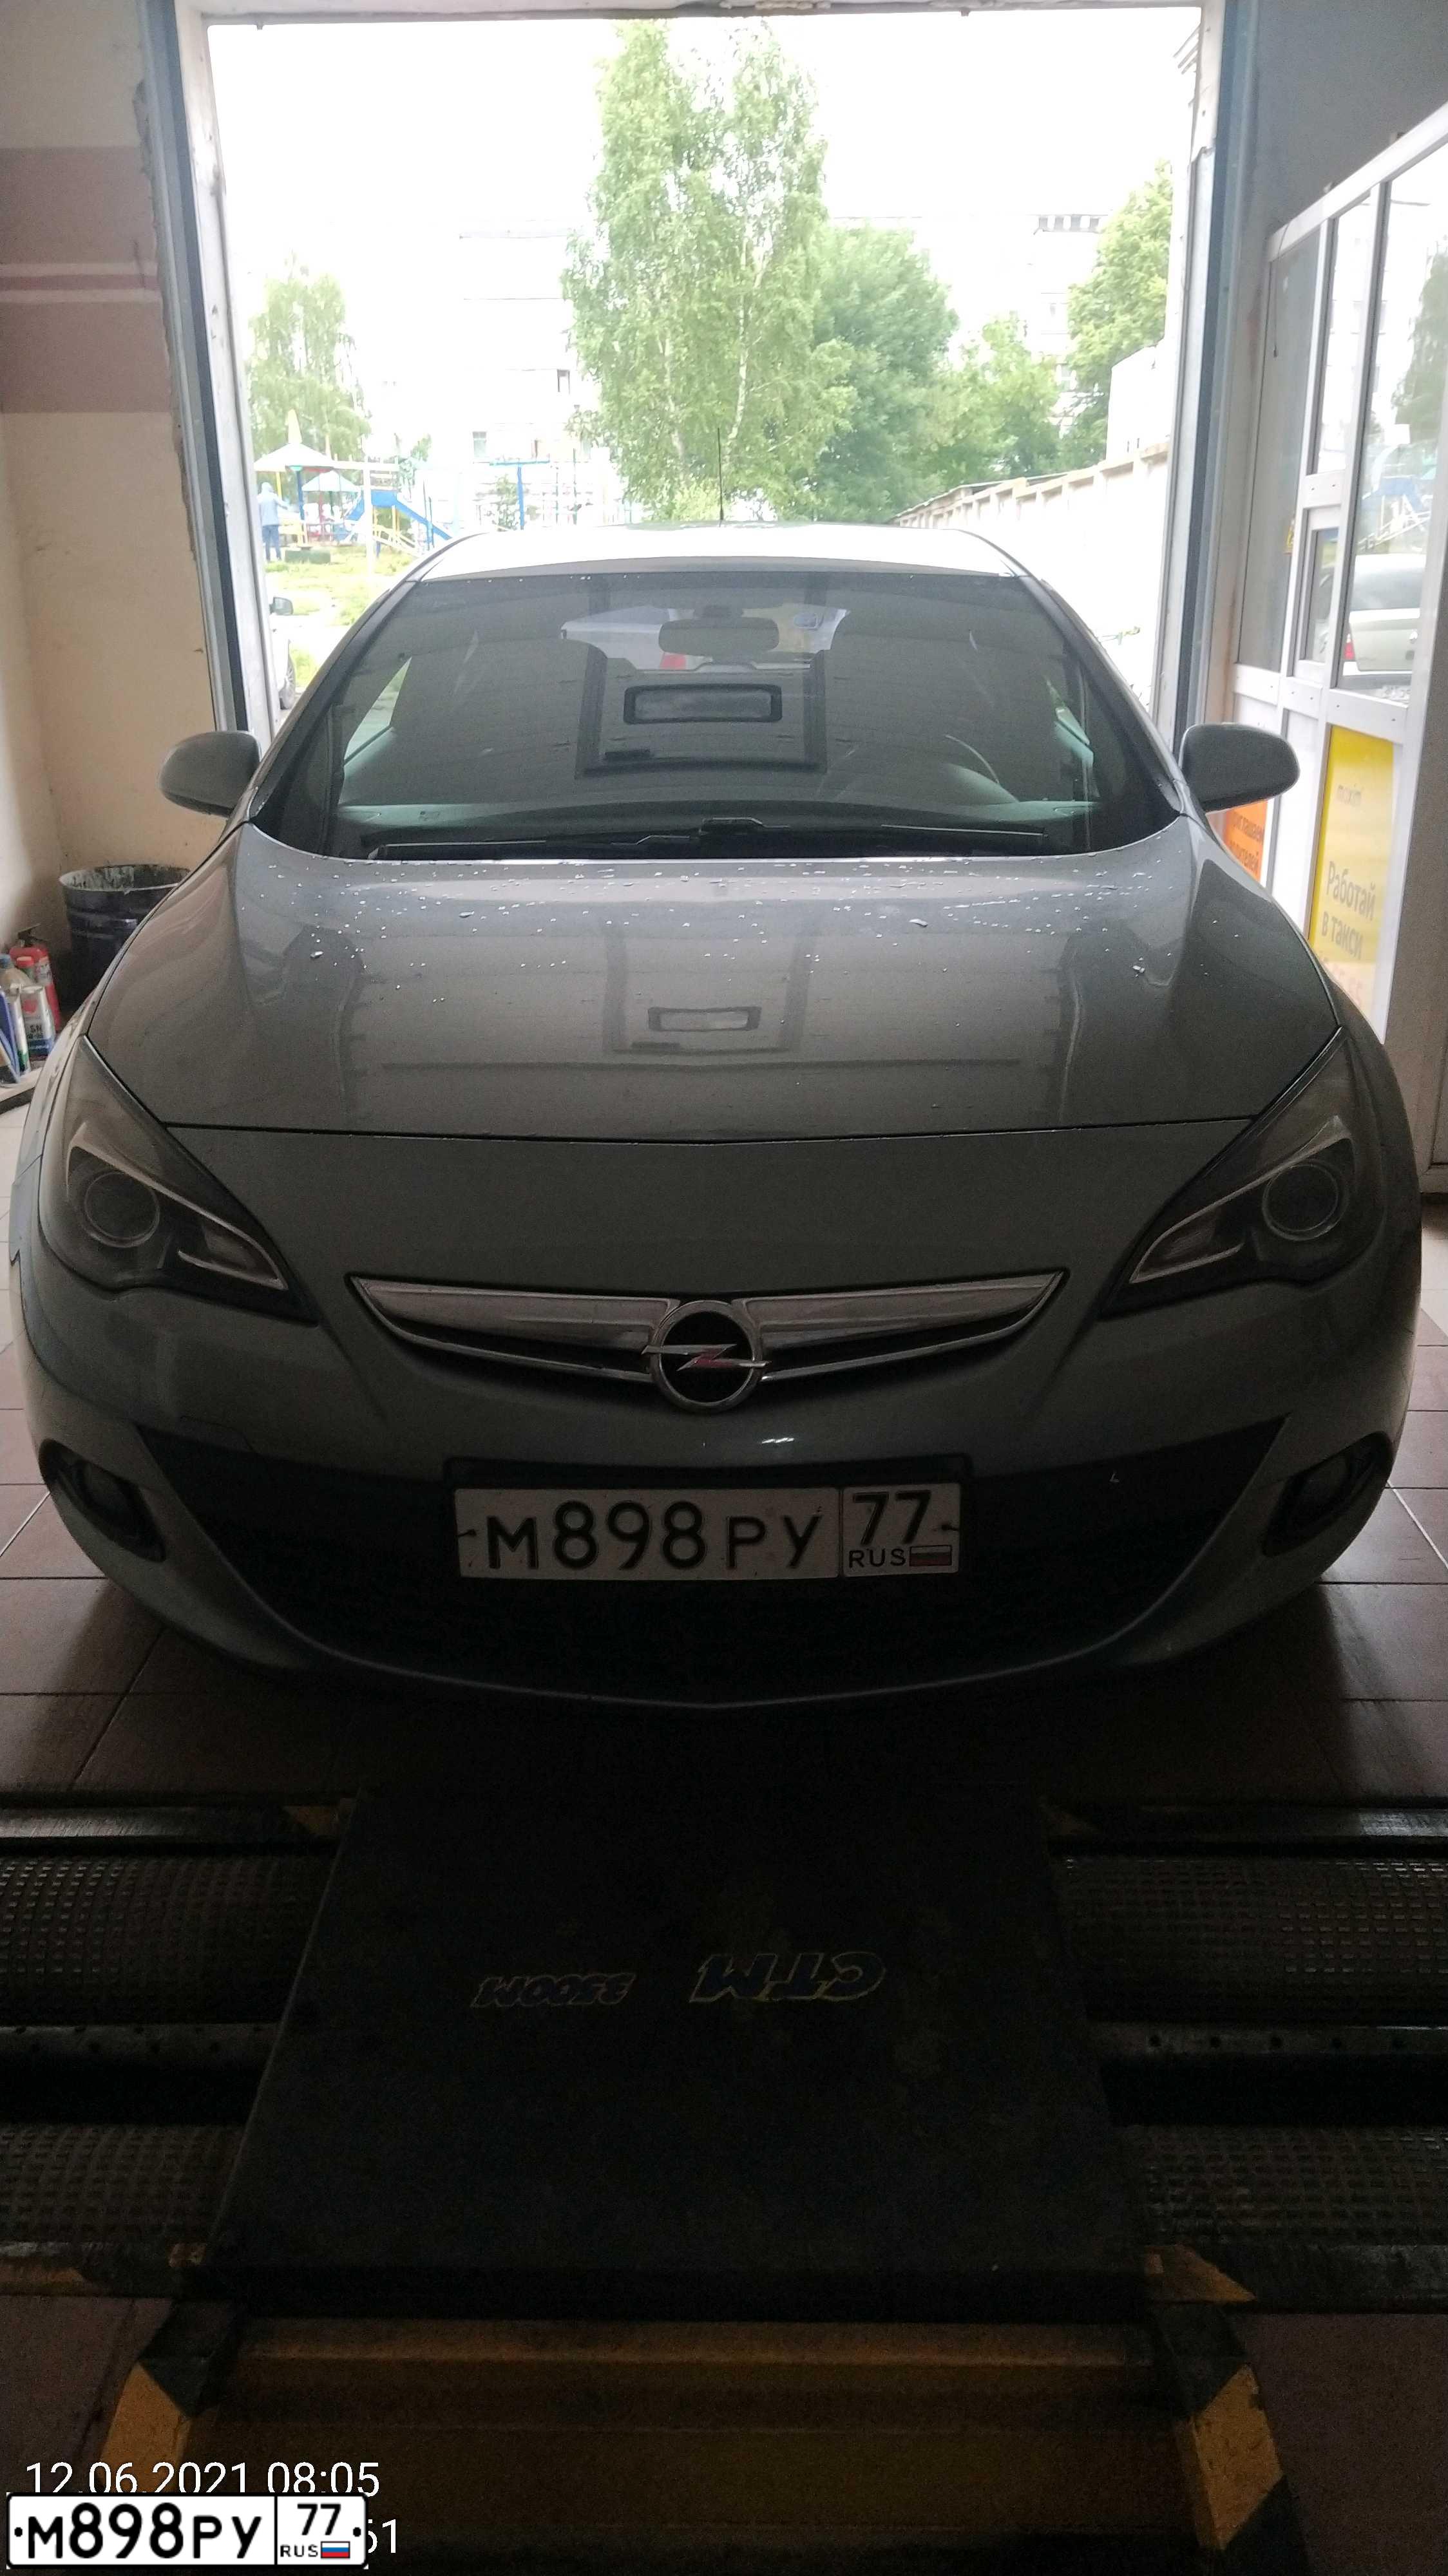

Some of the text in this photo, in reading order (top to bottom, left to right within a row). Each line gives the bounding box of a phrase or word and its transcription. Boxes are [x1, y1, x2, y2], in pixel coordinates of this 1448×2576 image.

[1326, 860, 1376, 921] Работай
[1322, 911, 1364, 961] в такси
[852, 1490, 932, 1546] 77
[848, 1547, 906, 1569] RUS
